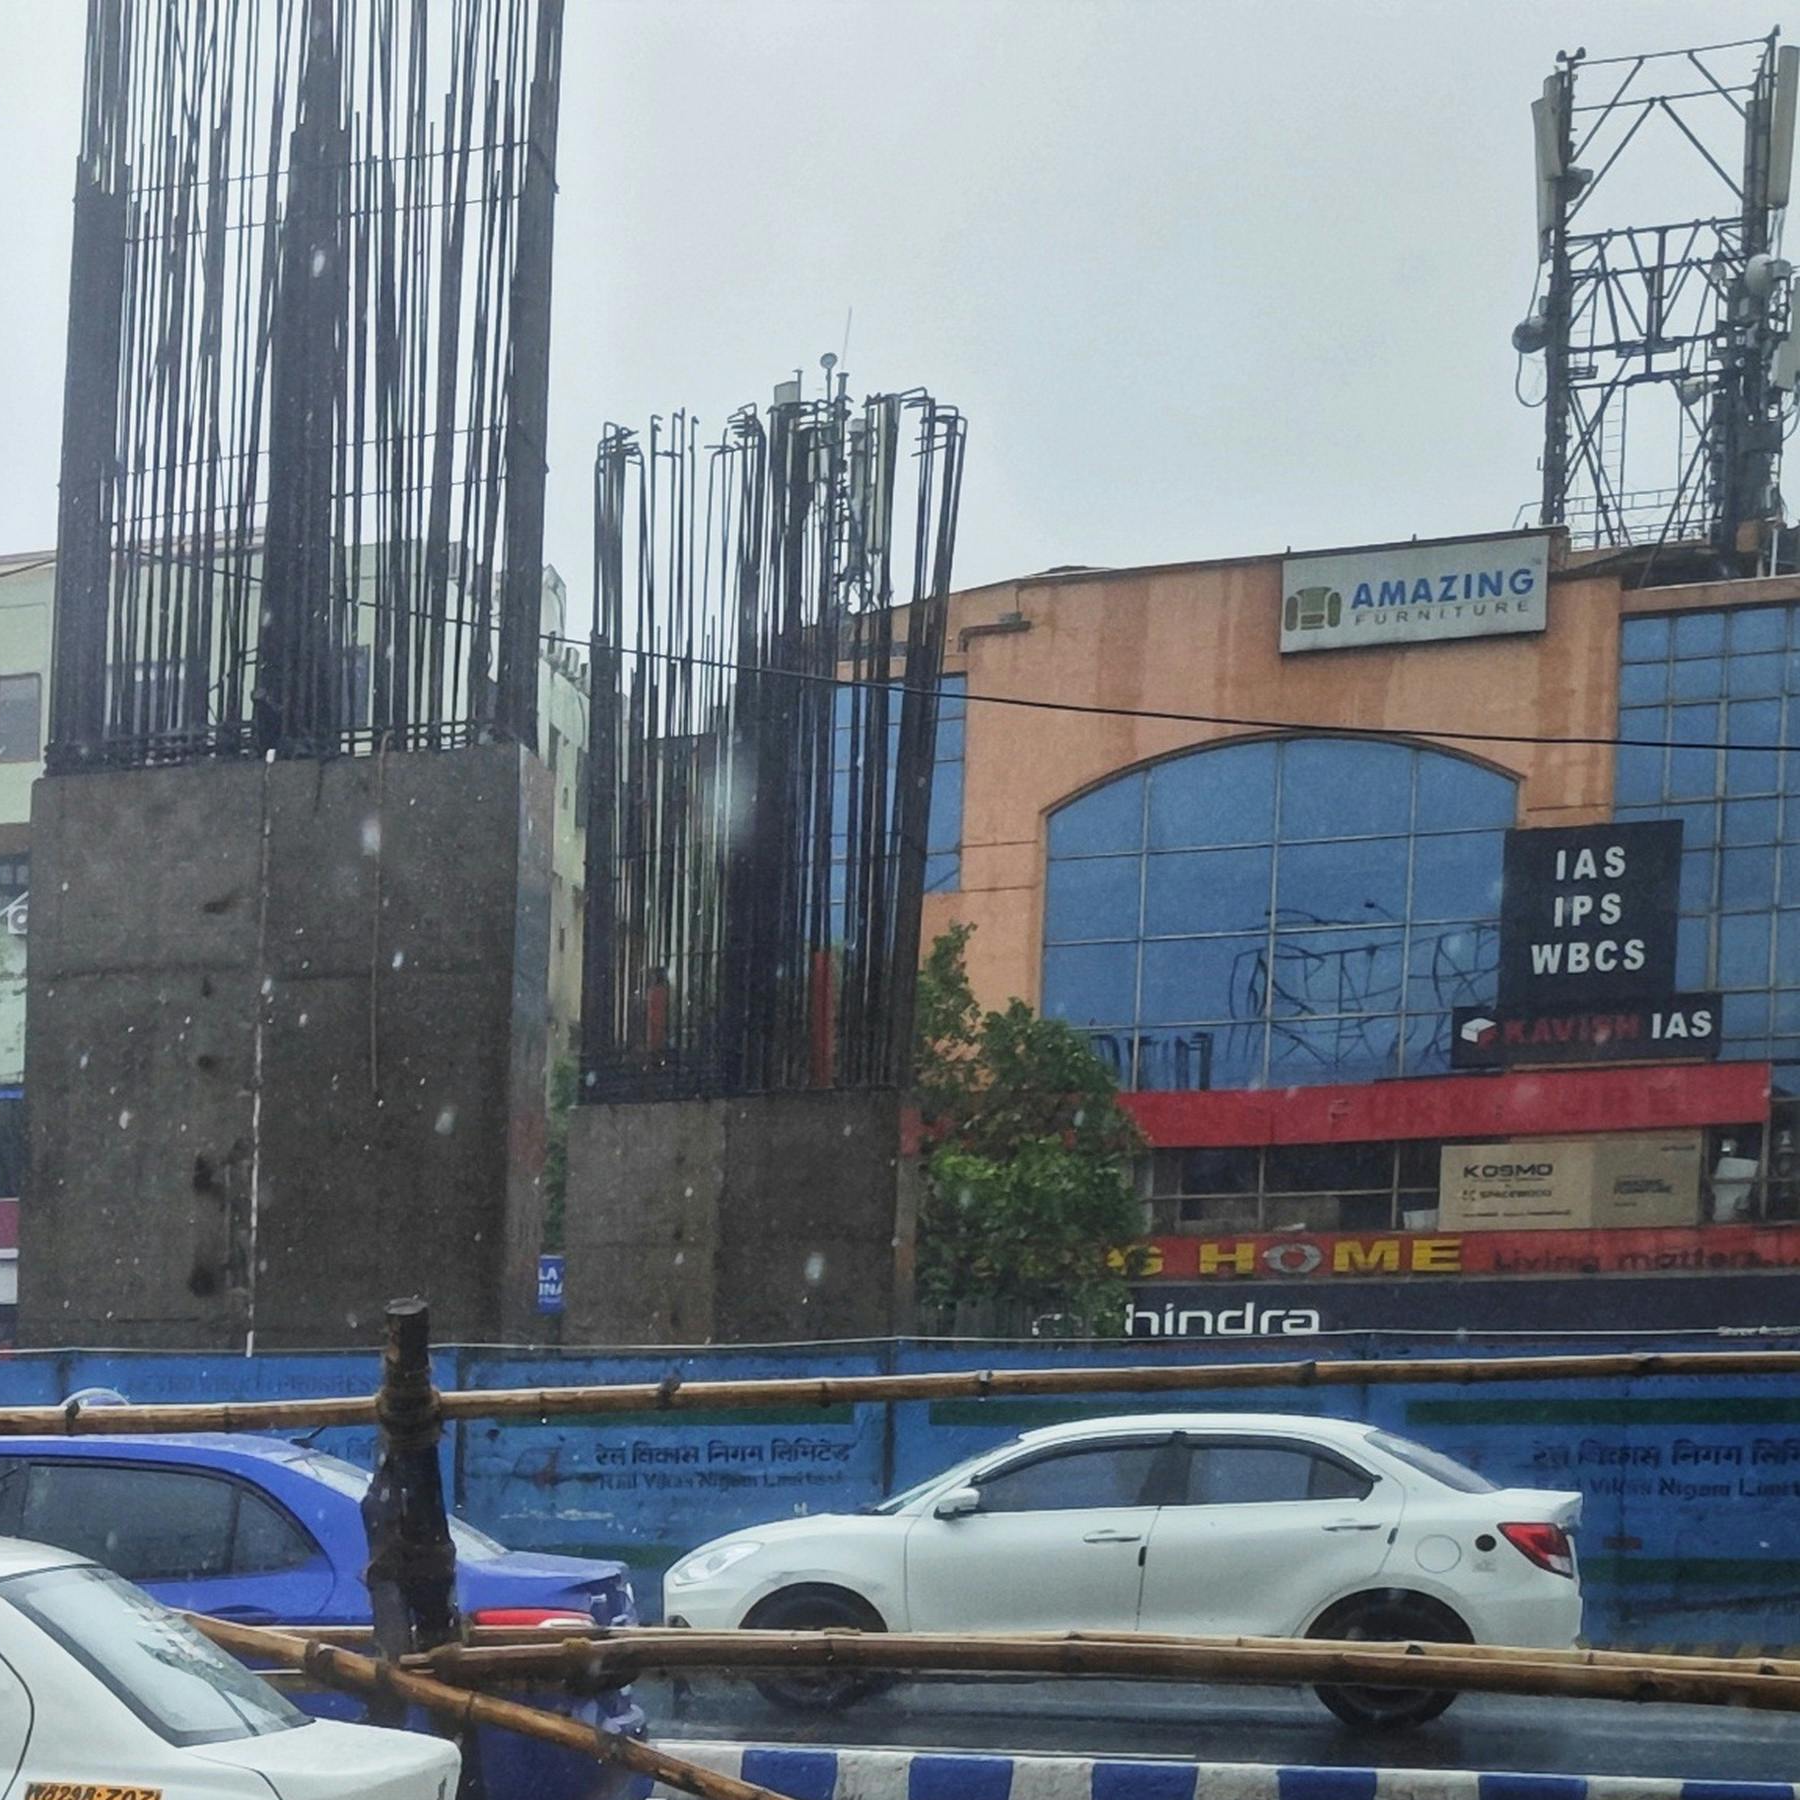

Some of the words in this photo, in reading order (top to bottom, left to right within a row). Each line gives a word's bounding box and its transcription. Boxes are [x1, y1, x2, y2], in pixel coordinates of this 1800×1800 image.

[1351, 568, 1534, 609] AMAZING
[1355, 602, 1529, 626] FURNITURE
[1556, 846, 1626, 881] IAS
[1553, 893, 1622, 927] IPS
[1531, 939, 1646, 975] WBCS
[1652, 1010, 1712, 1039] IAS
[1463, 1164, 1553, 1178] KOSMO
[1200, 1239, 1463, 1275] HOME
